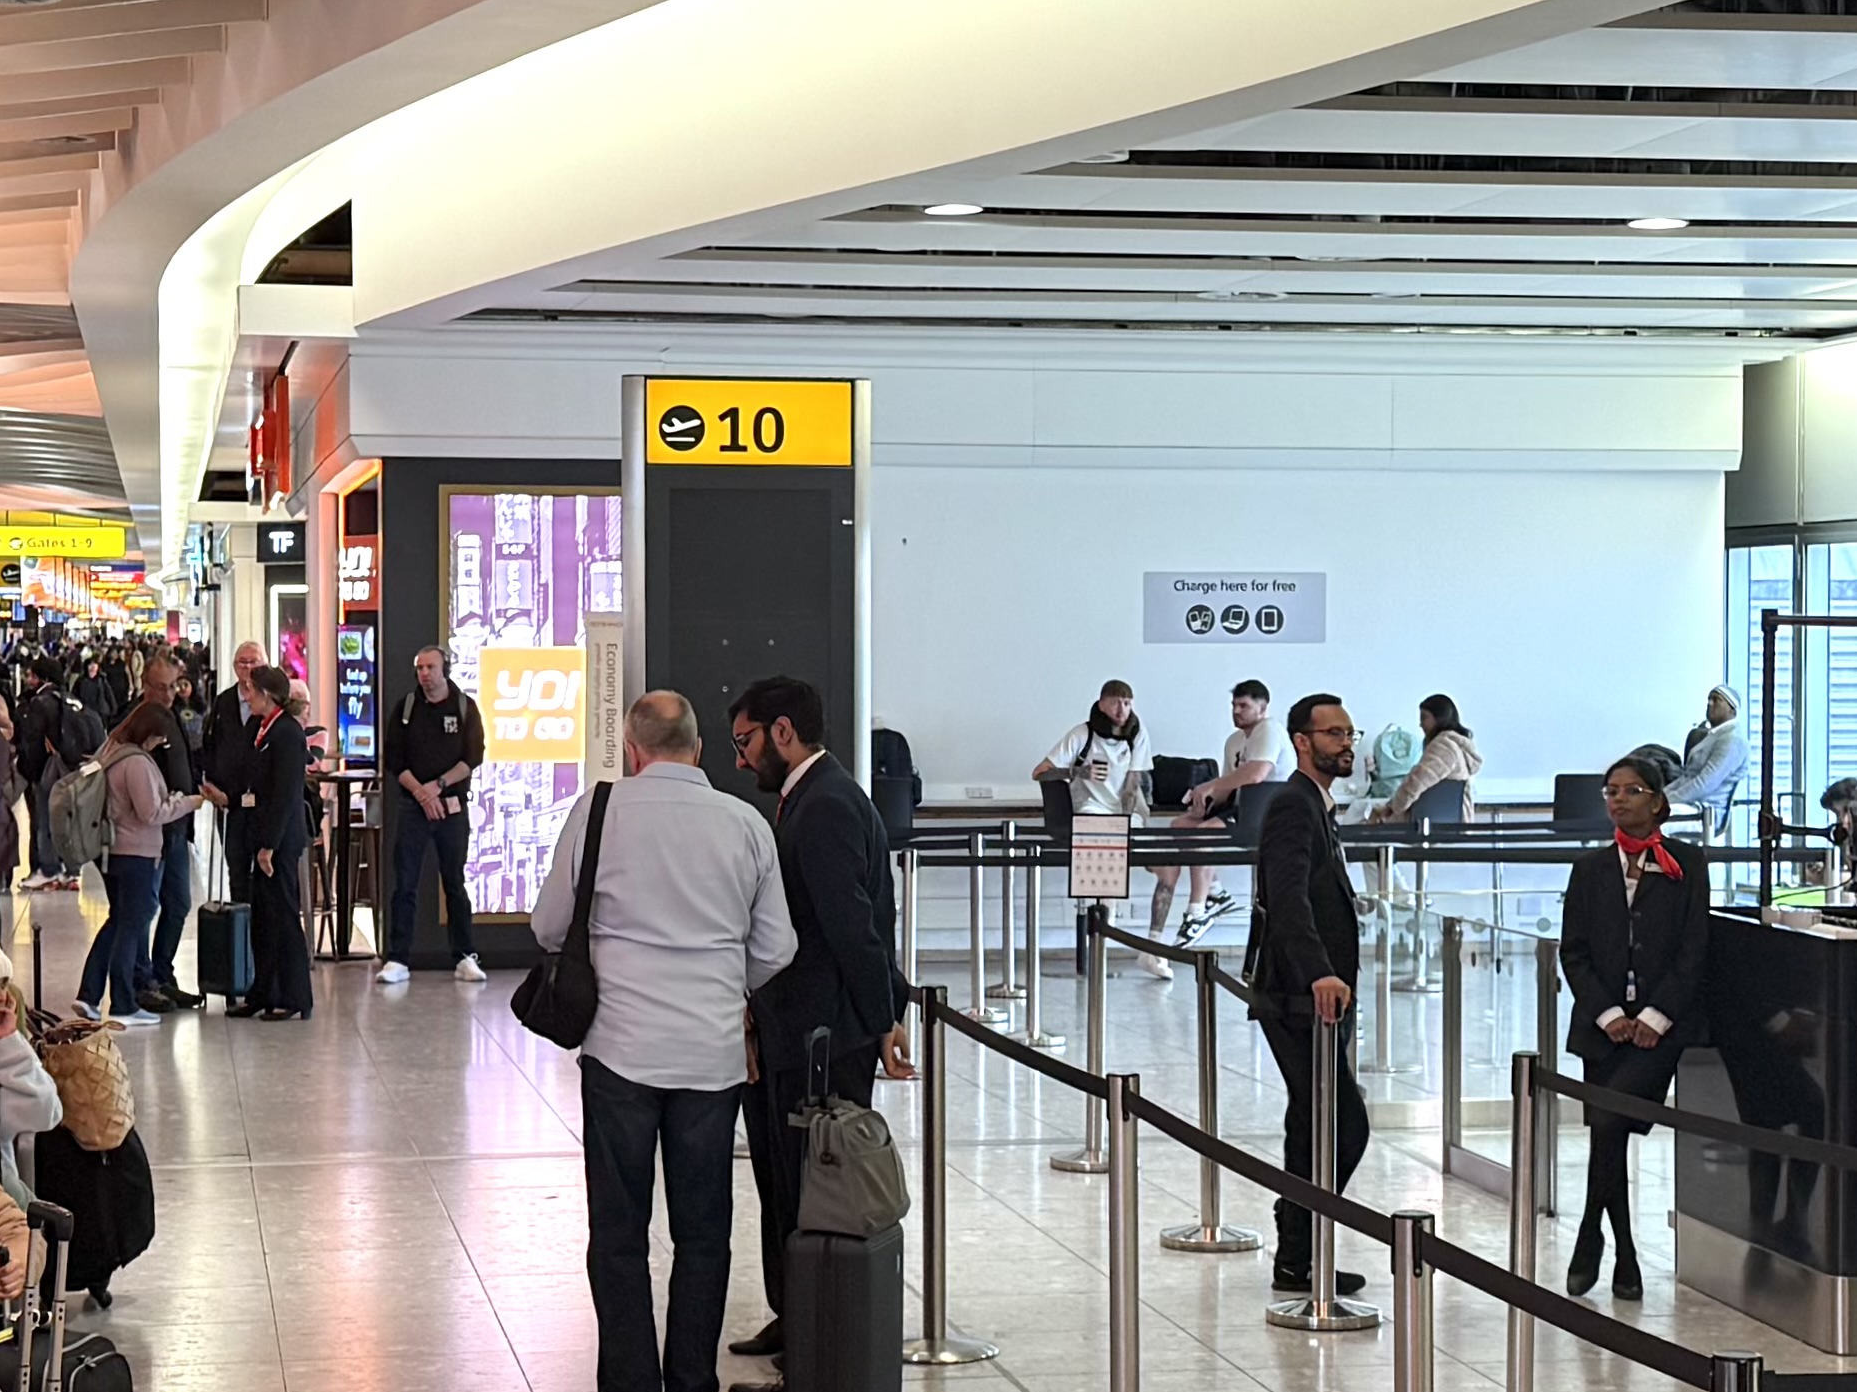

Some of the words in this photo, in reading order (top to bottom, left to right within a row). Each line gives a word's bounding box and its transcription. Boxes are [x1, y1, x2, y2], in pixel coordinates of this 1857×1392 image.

[717, 406, 785, 454] 10
[27, 536, 66, 548] Gates
[71, 537, 93, 549] 1-9
[1173, 579, 1218, 595] Charge
[1220, 579, 1248, 593] here
[1251, 579, 1269, 593] for
[1272, 579, 1297, 593] free
[603, 642, 618, 705] Economy
[603, 708, 618, 769] Boarding
